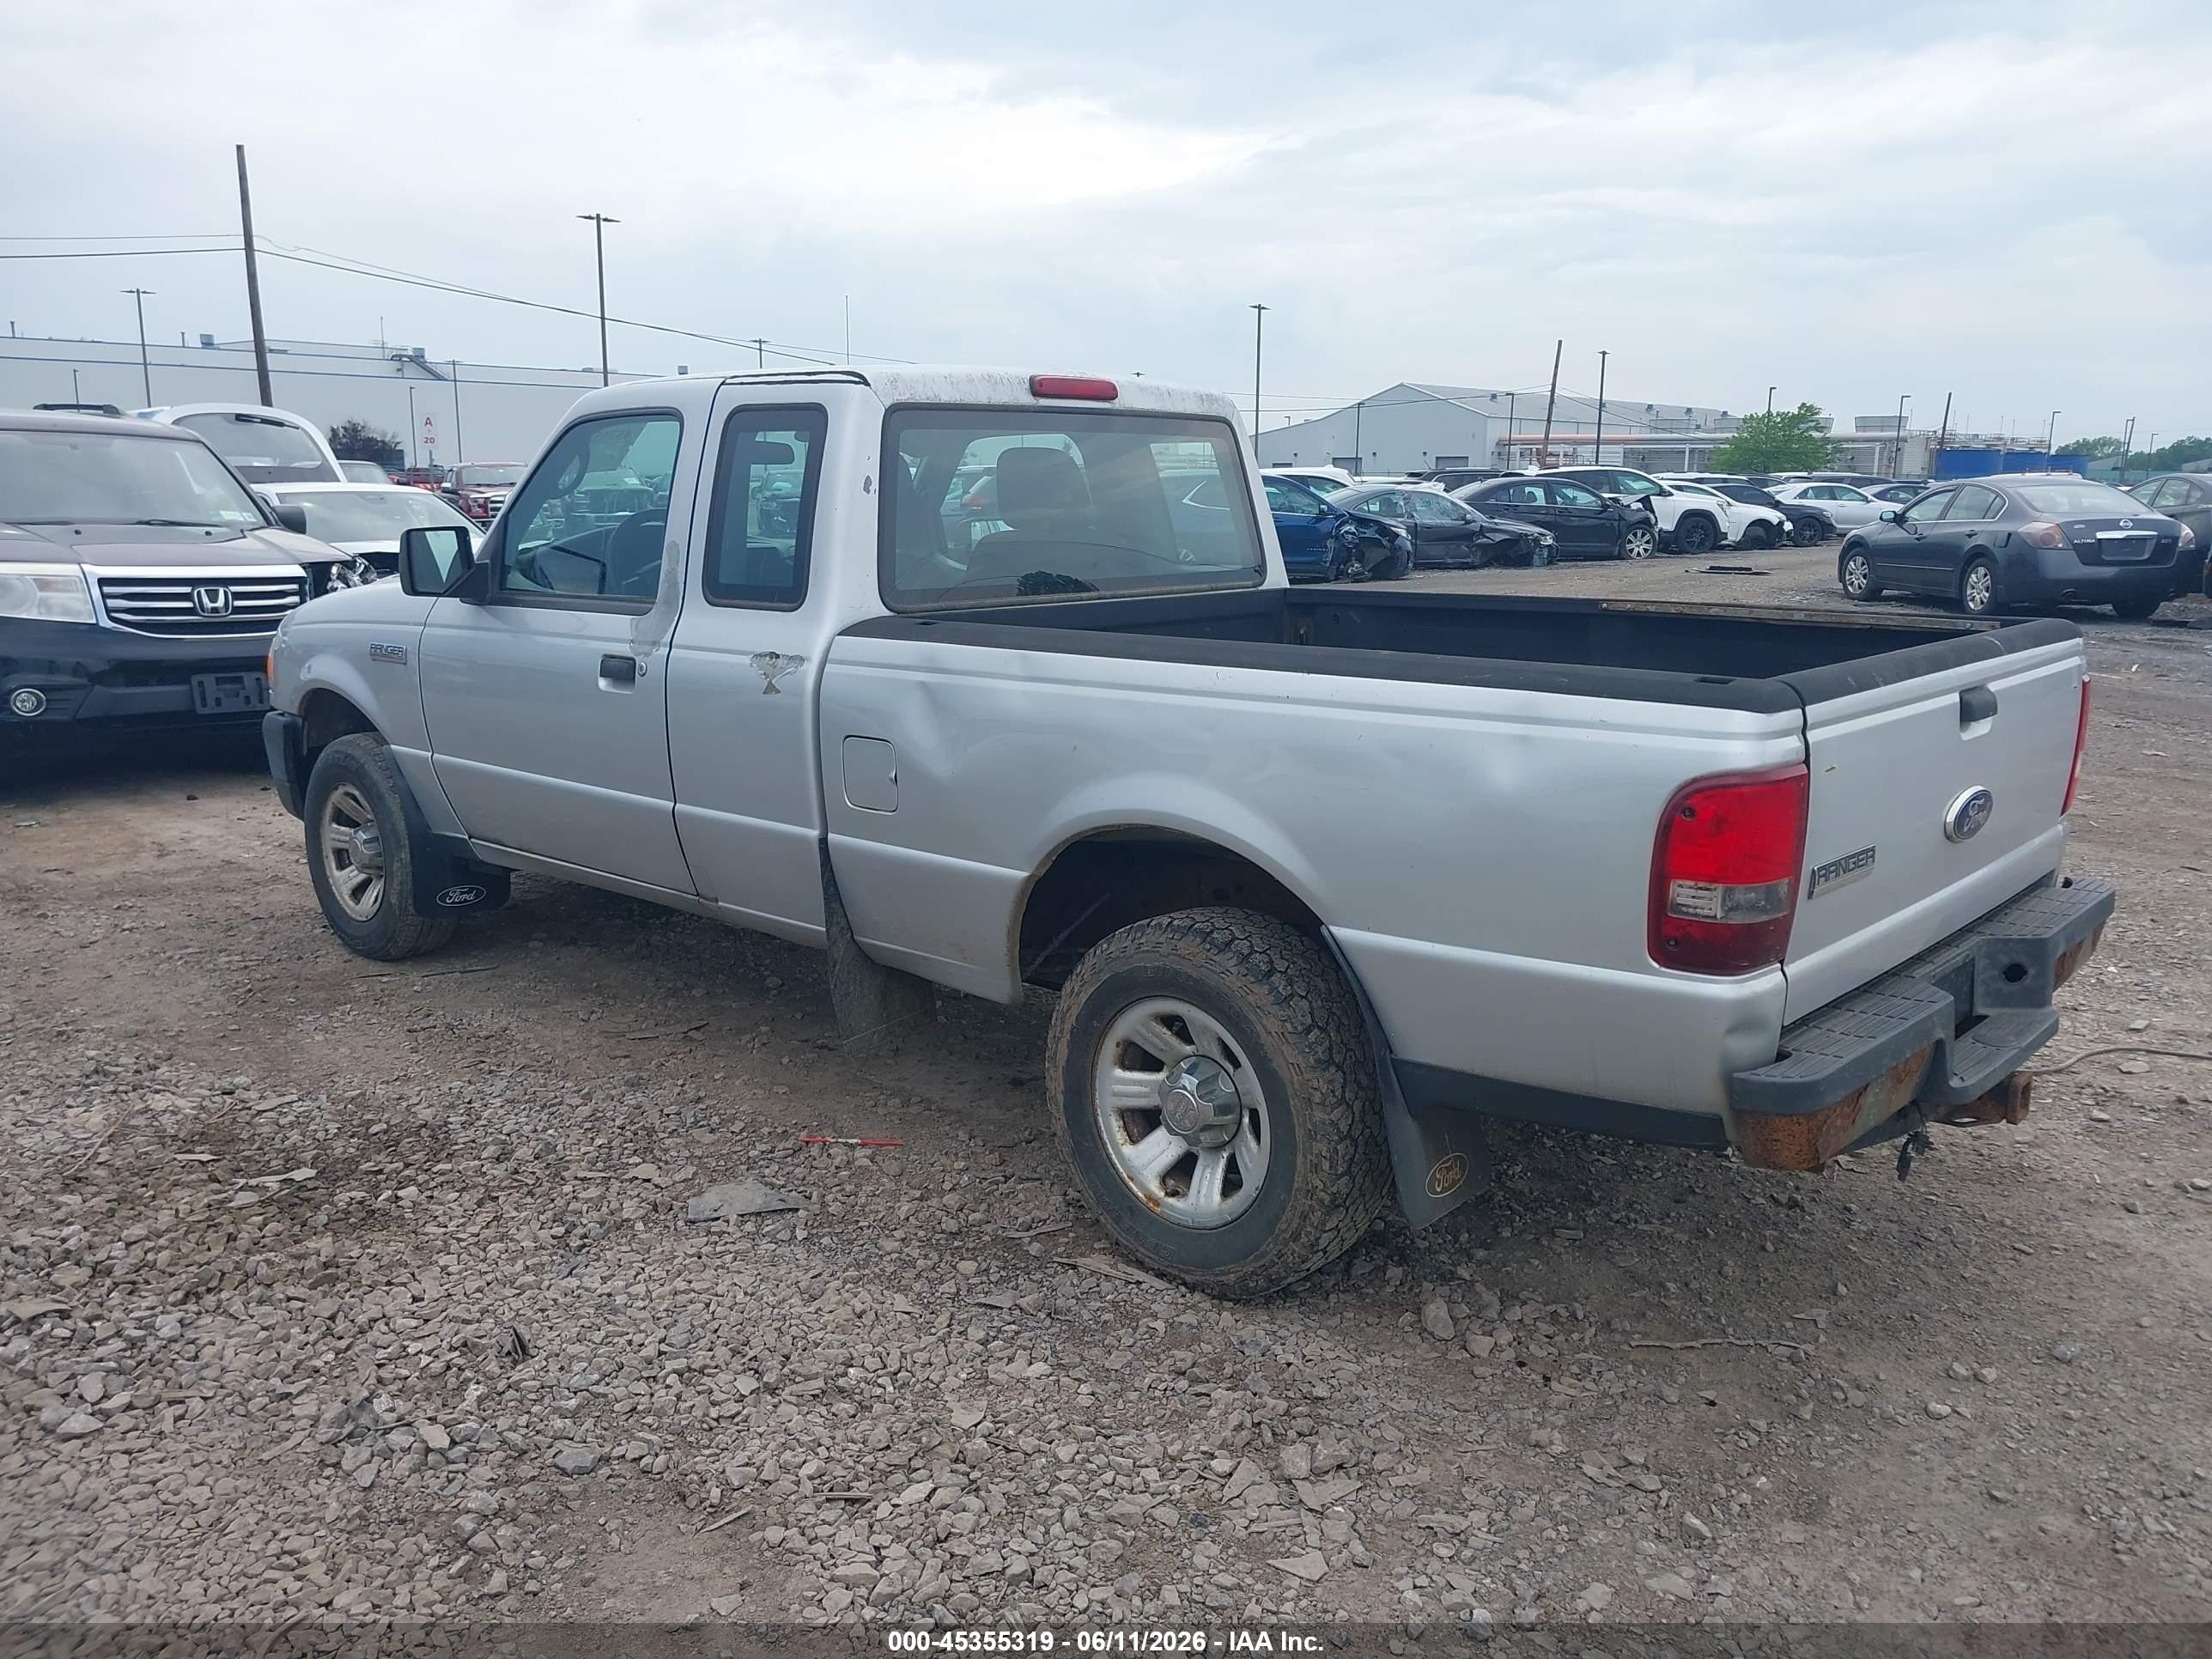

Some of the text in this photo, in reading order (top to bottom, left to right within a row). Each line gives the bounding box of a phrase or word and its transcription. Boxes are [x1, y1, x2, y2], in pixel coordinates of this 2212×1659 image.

[424, 416, 434, 427] A
[423, 436, 435, 445] 20
[370, 642, 405, 657] RANGER
[1816, 847, 1875, 885] RANGER
[446, 887, 477, 903] Ford
